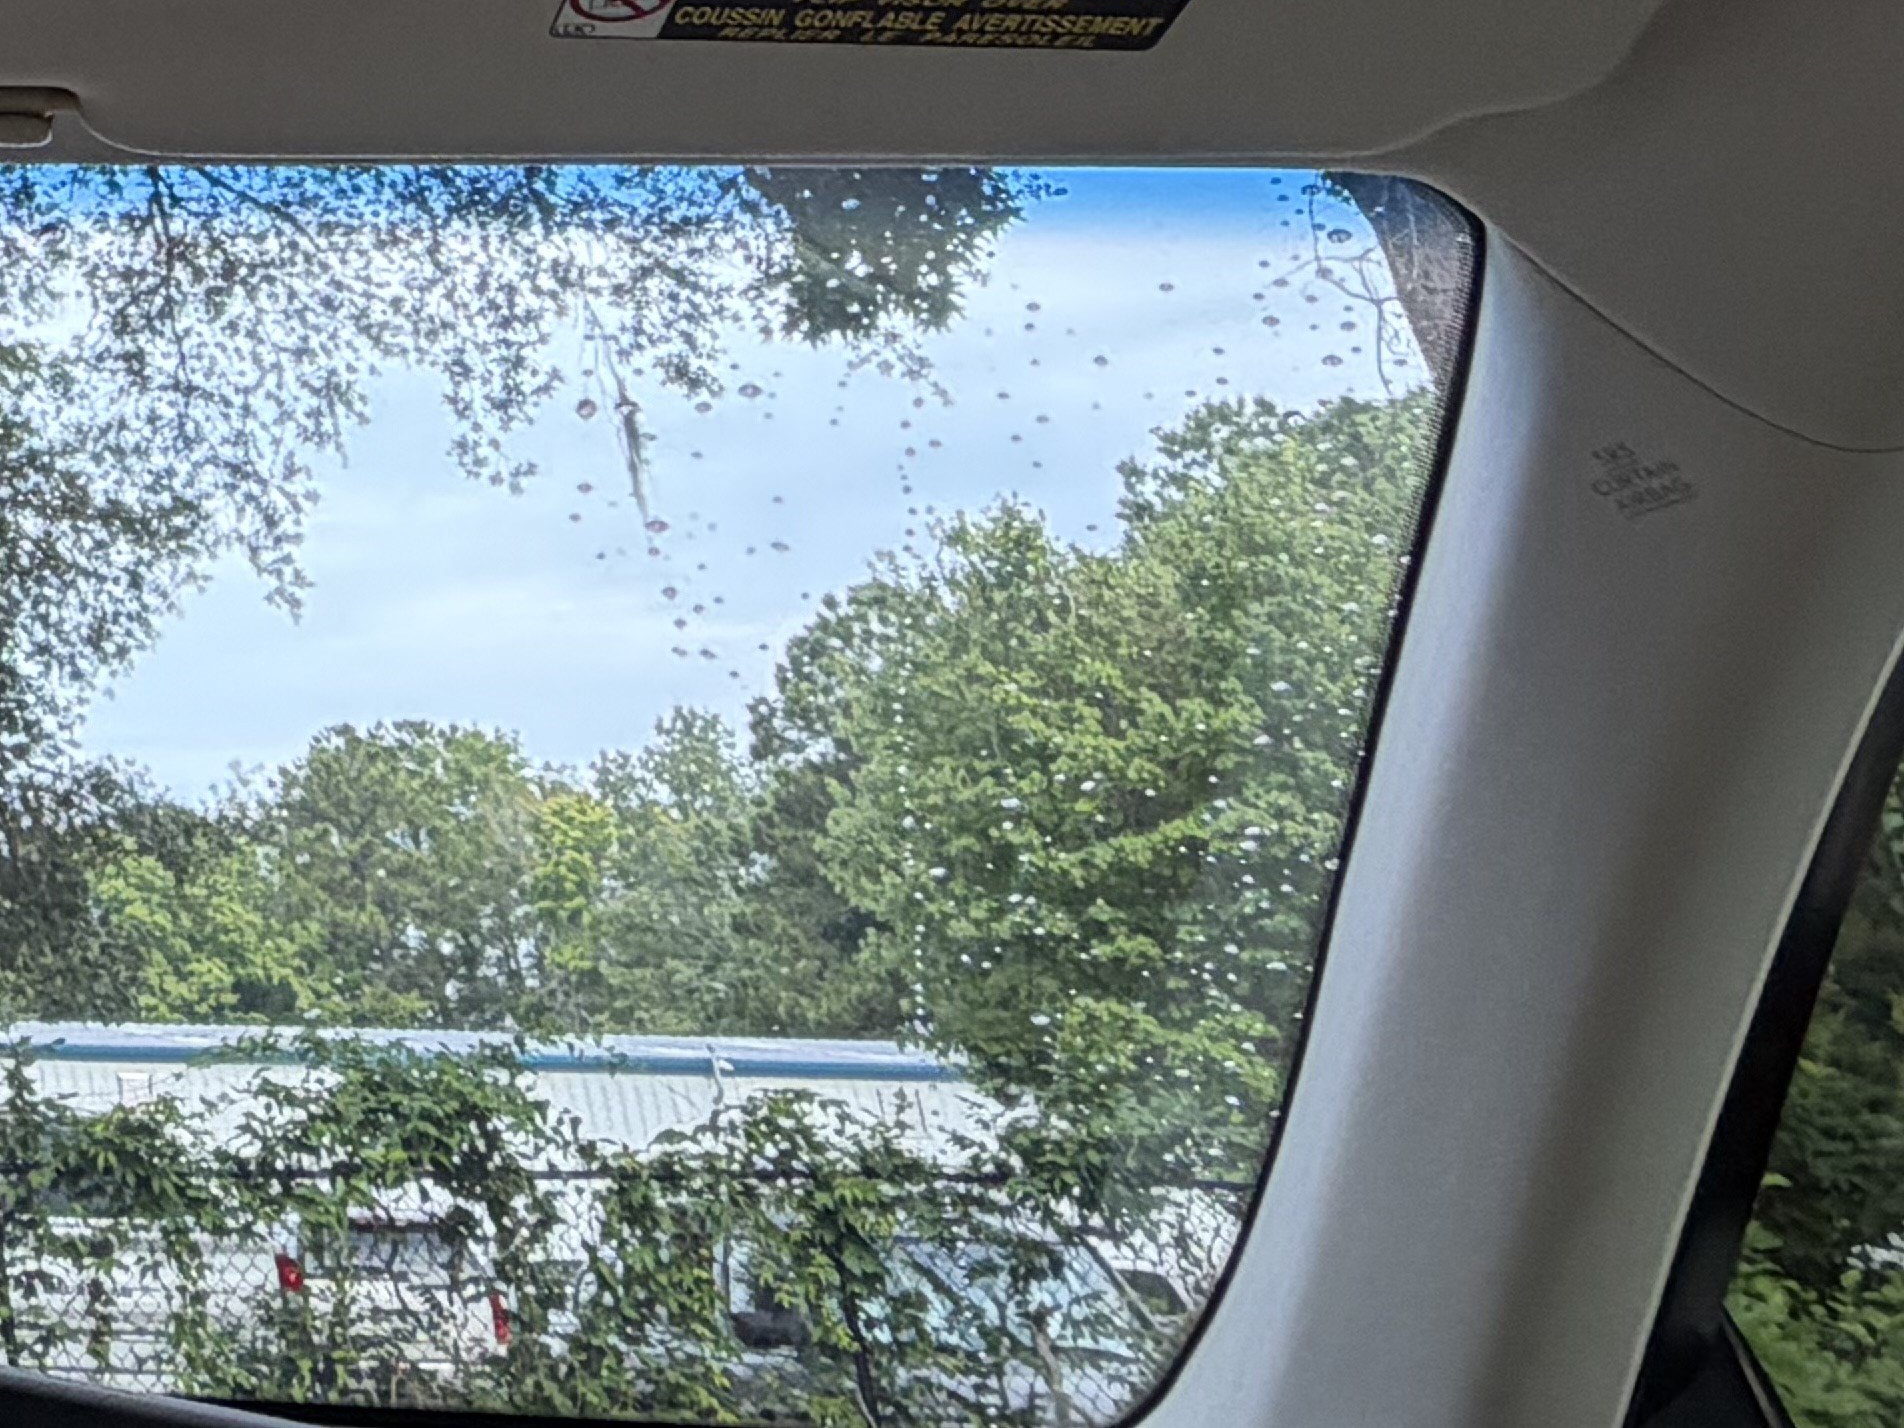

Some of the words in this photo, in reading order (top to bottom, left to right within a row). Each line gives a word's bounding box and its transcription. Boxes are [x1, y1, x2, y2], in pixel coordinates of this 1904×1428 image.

[674, 5, 786, 27] COUSSIN
[794, 8, 947, 32] GONFLABLE
[952, 12, 1164, 37] AVERTISSEMENT
